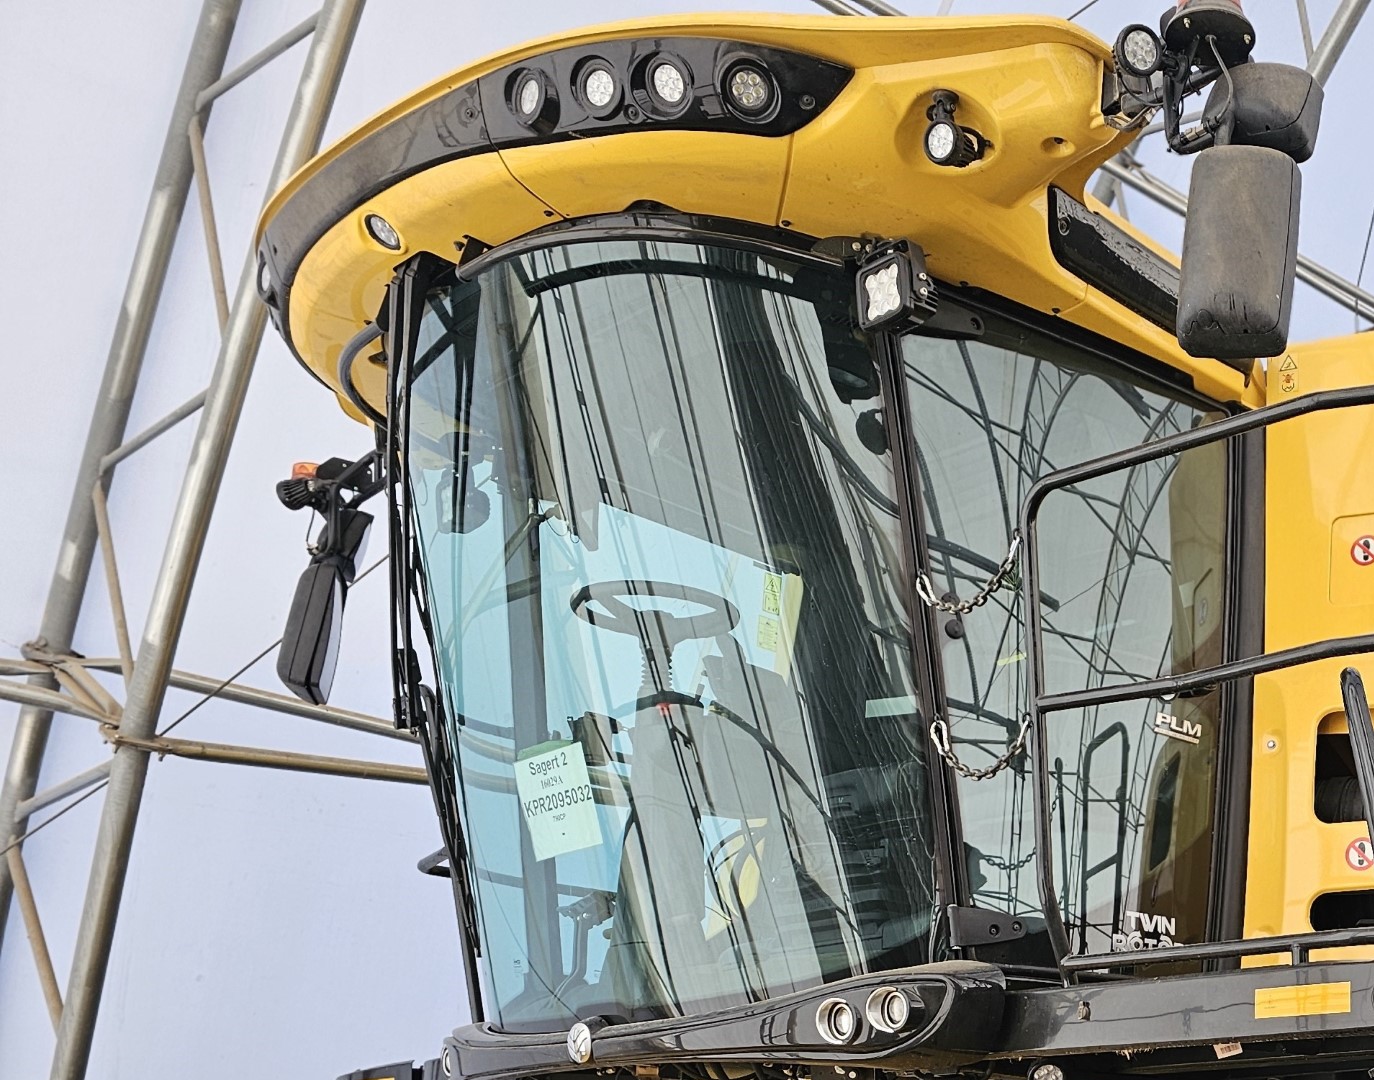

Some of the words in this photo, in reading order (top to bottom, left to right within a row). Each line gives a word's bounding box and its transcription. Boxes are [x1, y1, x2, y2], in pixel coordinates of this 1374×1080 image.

[1154, 711, 1203, 738] PLM
[528, 754, 560, 776] Sagert
[560, 751, 568, 767] 2
[523, 783, 593, 819] KPR2095032
[1126, 910, 1176, 936] TWIN
[1112, 930, 1184, 953] ROTO
